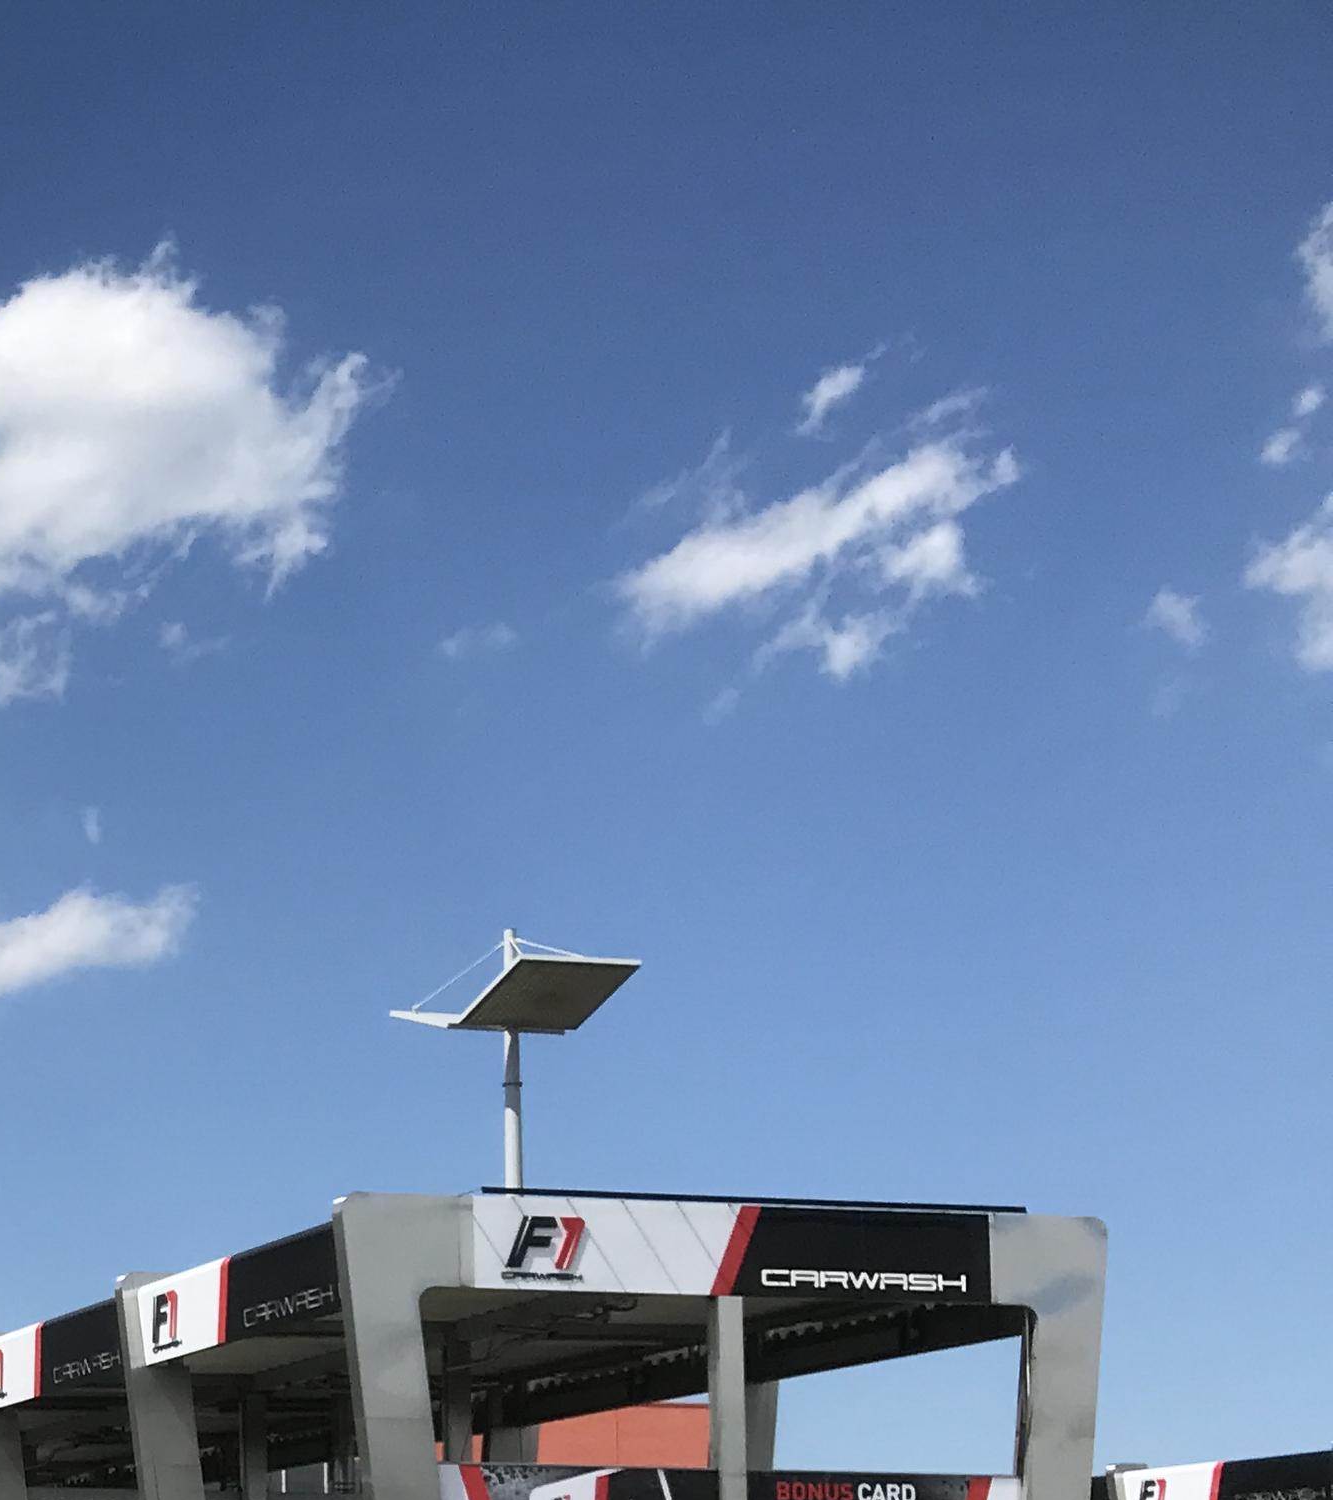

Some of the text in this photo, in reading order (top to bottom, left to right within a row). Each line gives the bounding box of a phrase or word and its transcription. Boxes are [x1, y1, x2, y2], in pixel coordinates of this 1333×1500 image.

[505, 1216, 586, 1270] F1
[761, 1269, 967, 1293] CARWASH
[152, 1290, 178, 1344] F1
[243, 1284, 334, 1328] CARWASH
